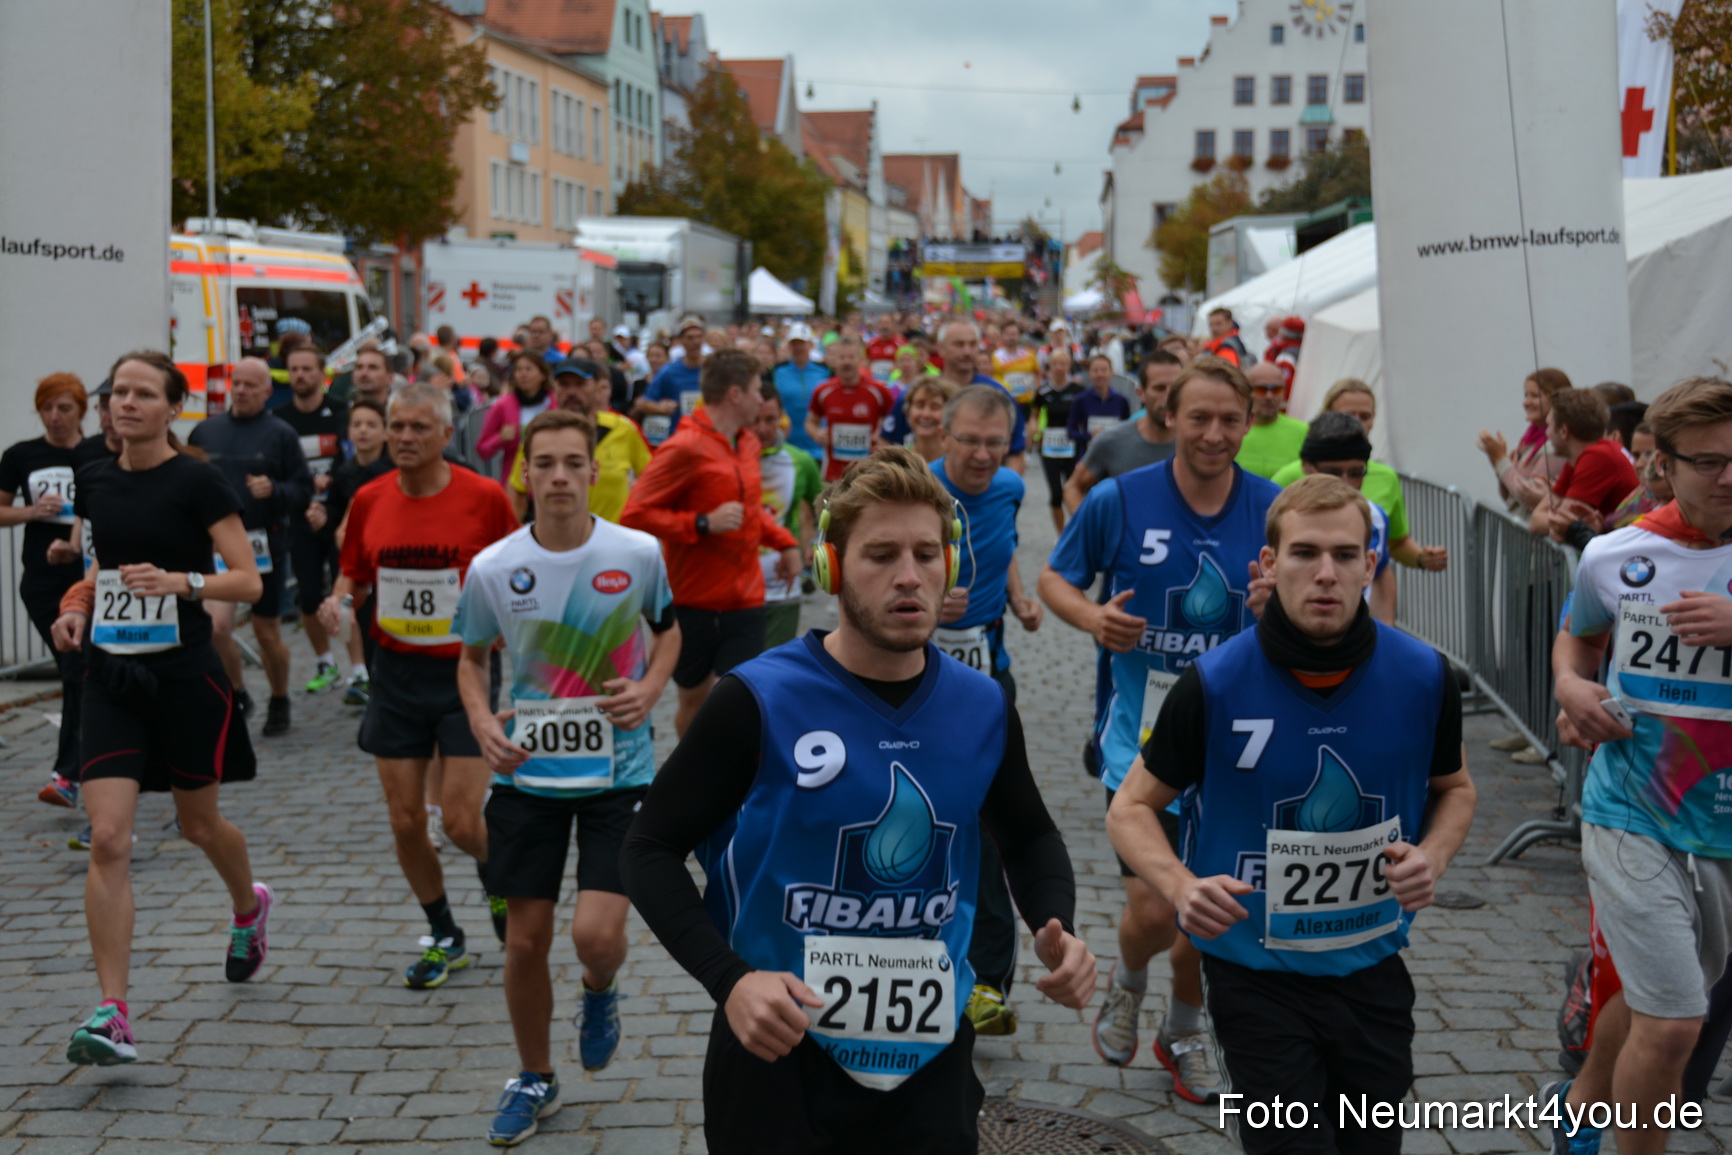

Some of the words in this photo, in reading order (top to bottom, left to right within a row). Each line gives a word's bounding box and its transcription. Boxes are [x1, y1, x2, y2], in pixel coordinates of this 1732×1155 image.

[1417, 226, 1620, 258] www.bmw-laufsport.de
[1138, 528, 1173, 566] 5
[402, 589, 436, 617] 48
[1623, 611, 1663, 627] PARTL
[1629, 630, 1732, 678] 2471
[1658, 682, 1698, 702] Heni
[520, 719, 604, 753] 3098
[1231, 718, 1275, 769] 7
[793, 729, 847, 789] 9
[1271, 843, 1320, 856] PARTL
[1323, 836, 1384, 857] Neumarkt
[1283, 852, 1392, 907] 2279
[1293, 910, 1382, 936] Alexander
[810, 951, 864, 968] PARTL
[868, 954, 933, 970] Neumarkt
[816, 975, 944, 1034] 2152
[824, 1042, 920, 1070] Korbinian
